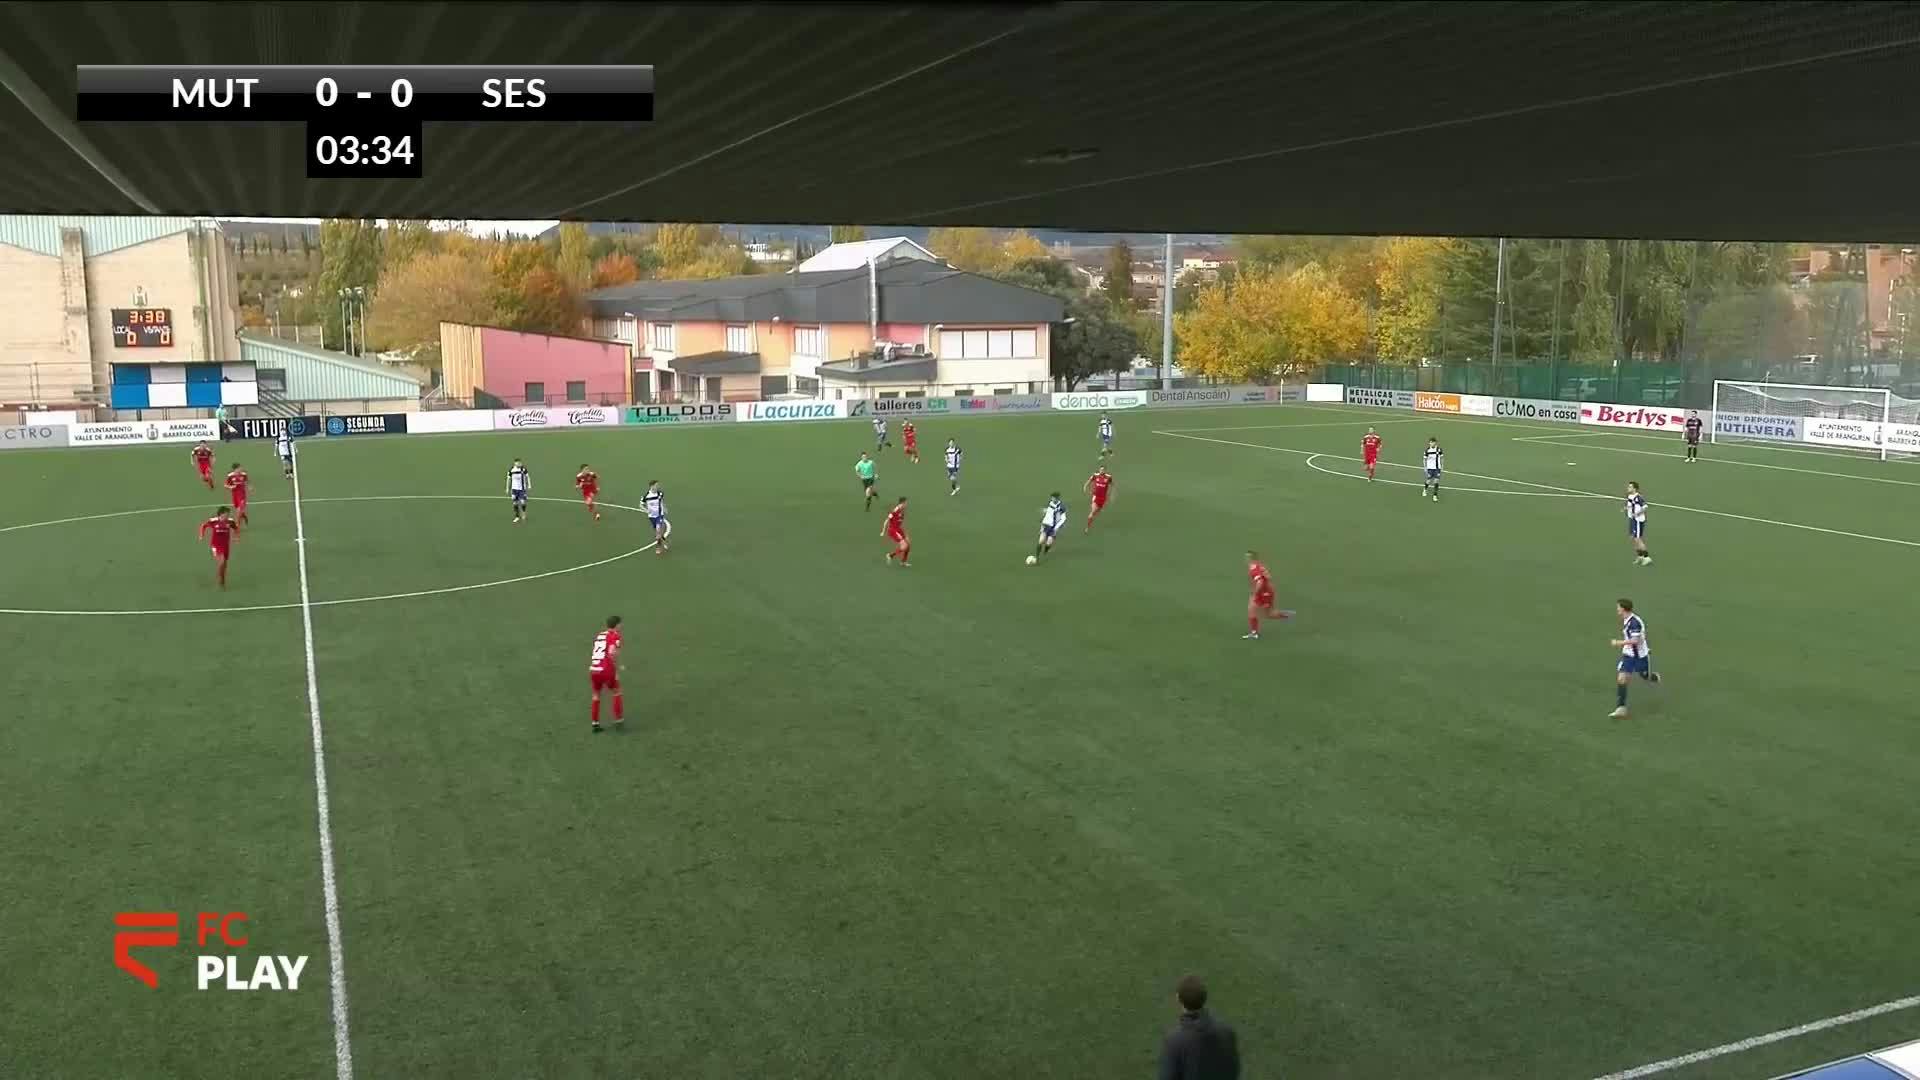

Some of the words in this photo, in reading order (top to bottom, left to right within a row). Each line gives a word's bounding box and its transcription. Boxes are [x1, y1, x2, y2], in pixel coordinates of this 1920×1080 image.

[1152, 390, 1185, 402] Dental
[1350, 389, 1393, 399] METALICAS
[874, 399, 922, 411] talleres
[1060, 393, 1109, 408] denda
[1350, 397, 1393, 407] MUTILVA
[631, 404, 731, 417] TOLDOS
[753, 403, 836, 419] Lacunza
[1538, 408, 1551, 418] en
[1554, 408, 1577, 420] casa
[1597, 405, 1667, 427] Berlys
[169, 423, 207, 431] ARANGUREN
[346, 416, 385, 428] SEGUNDA
[84, 426, 133, 434] AYUNTAMIENTO
[104, 432, 143, 440] ARANGUREN
